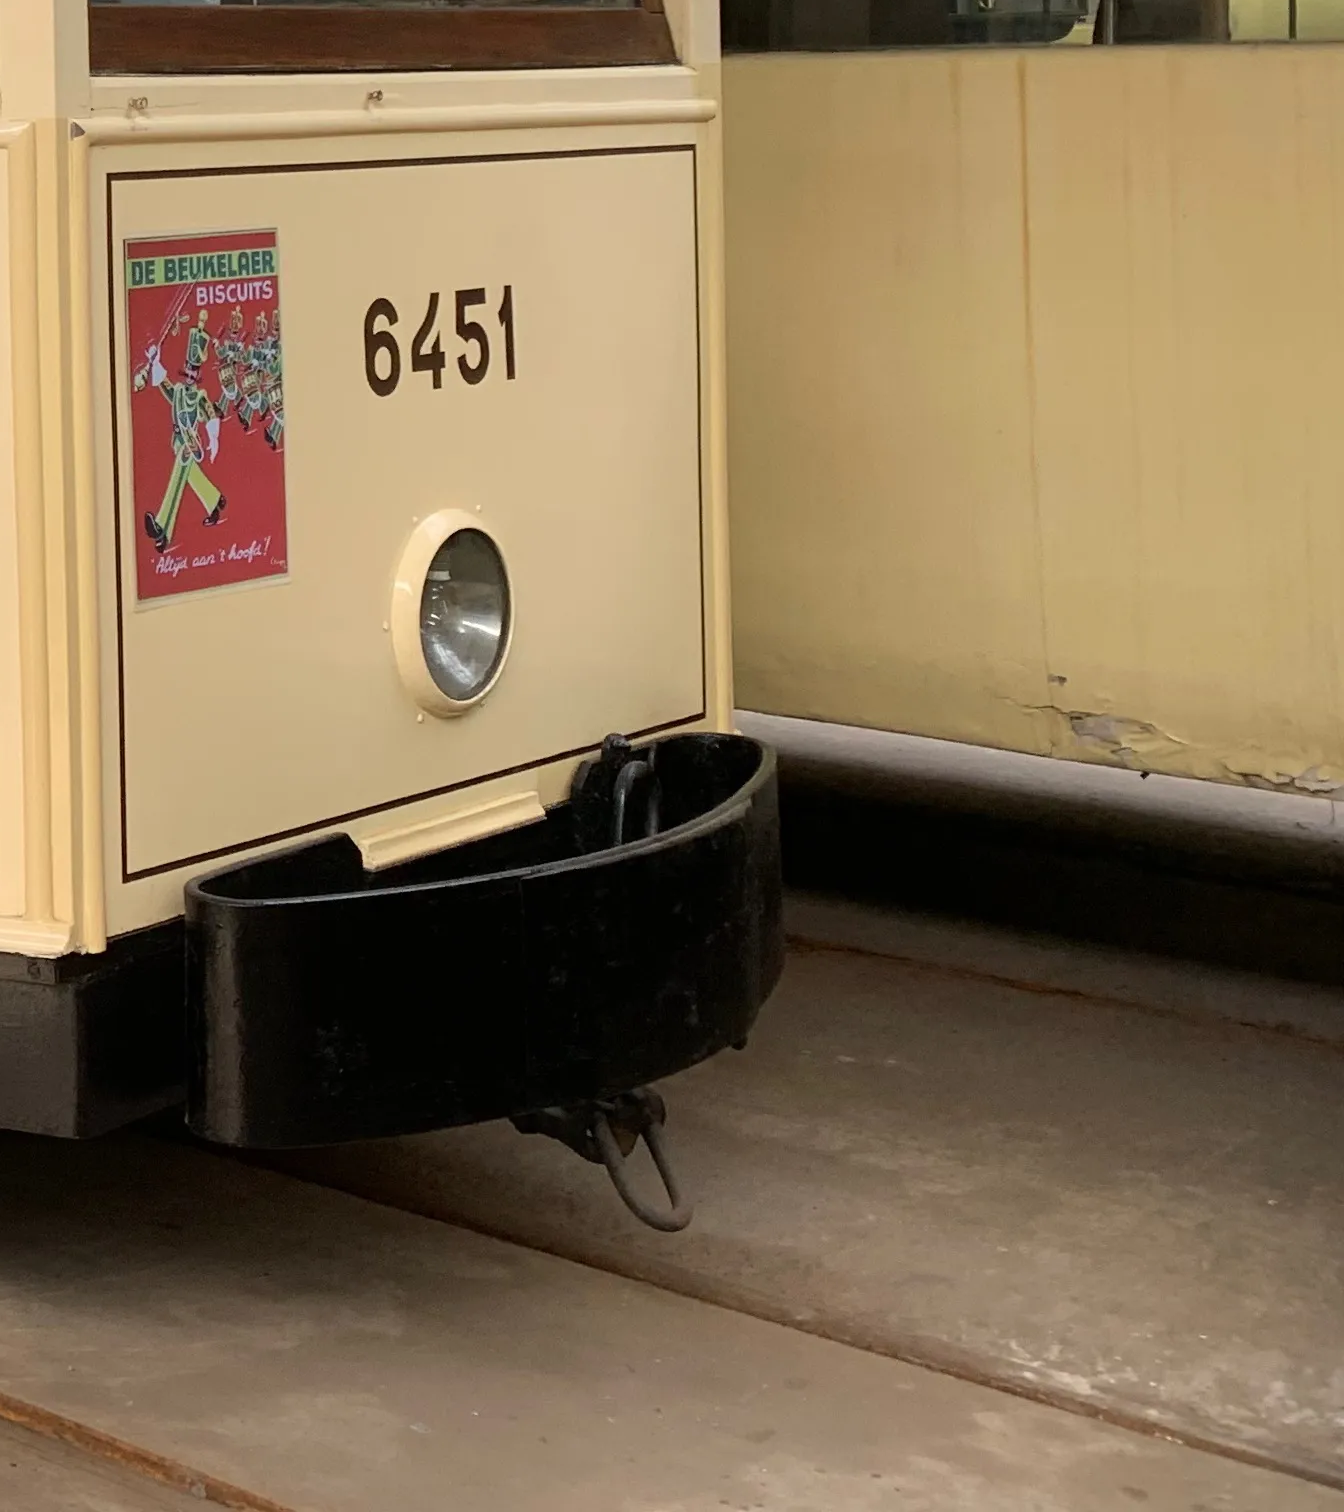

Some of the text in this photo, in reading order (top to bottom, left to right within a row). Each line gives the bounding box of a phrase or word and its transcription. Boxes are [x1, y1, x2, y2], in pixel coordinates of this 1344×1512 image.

[131, 250, 275, 286] DE BEUKELAER
[196, 280, 273, 306] BISCUITS
[363, 285, 516, 397] 6451
